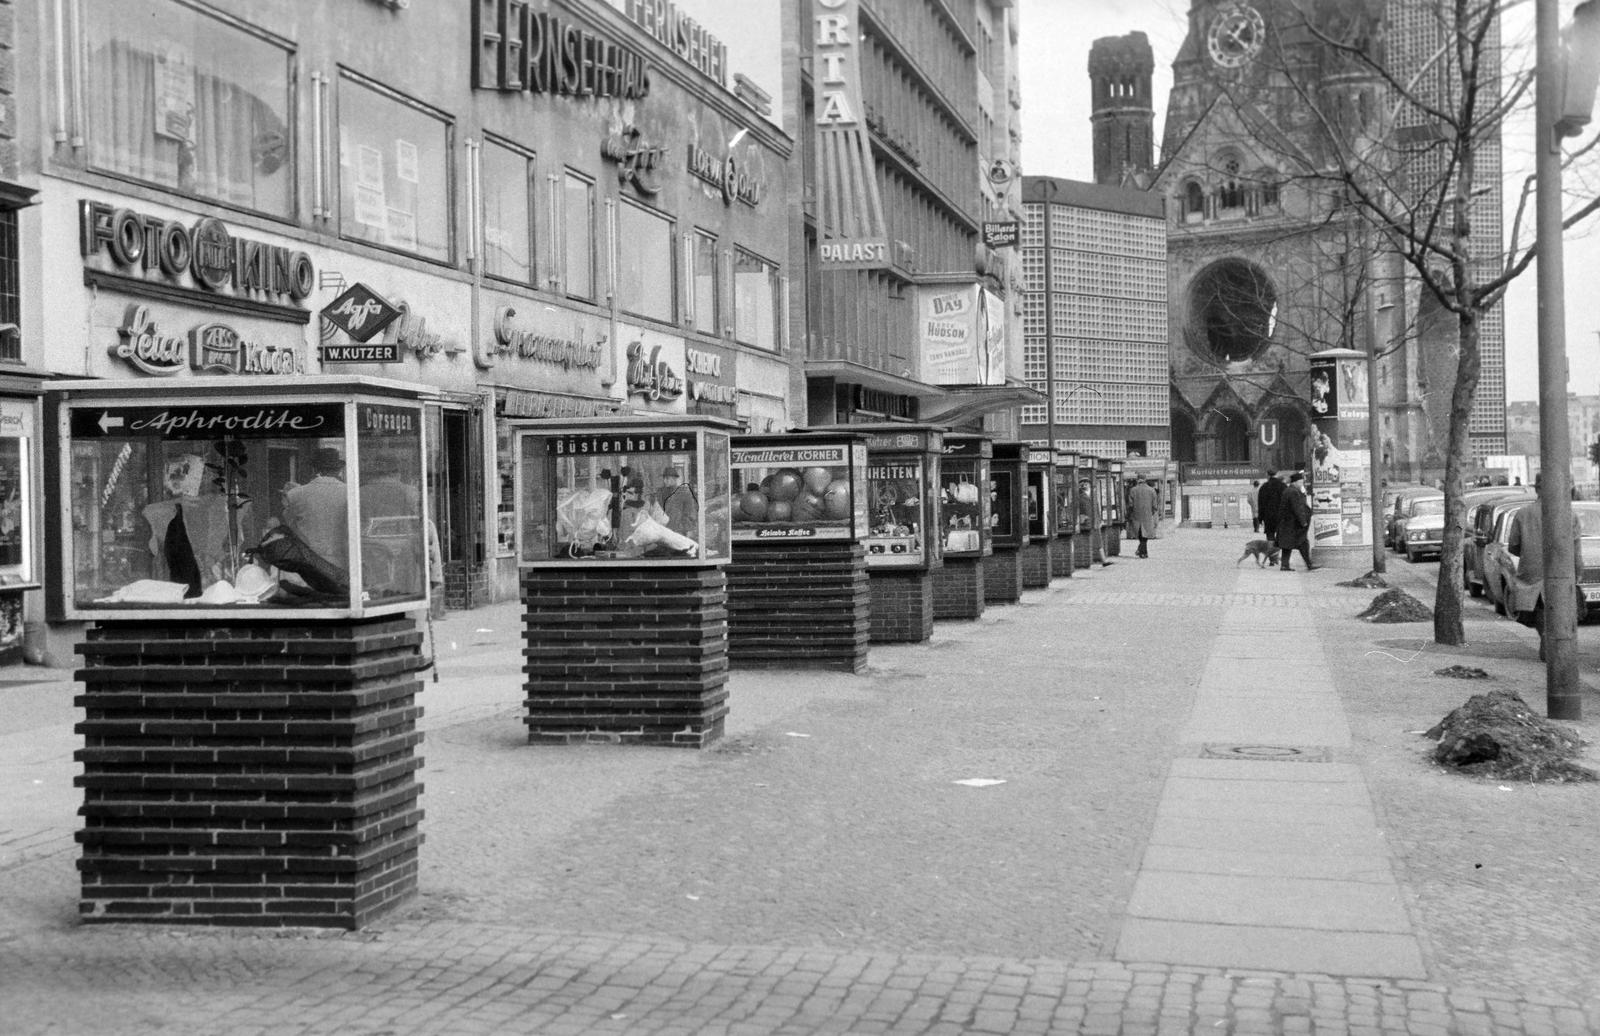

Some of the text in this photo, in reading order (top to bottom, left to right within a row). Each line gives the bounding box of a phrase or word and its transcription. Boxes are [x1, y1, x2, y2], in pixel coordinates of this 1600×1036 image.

[984, 223, 1017, 233] Billard-
[986, 232, 1015, 242] Salon
[79, 199, 314, 300] FOTO KINO
[820, 242, 884, 263] PALAST
[332, 296, 382, 330] Agfa
[933, 297, 963, 315] DAY
[115, 304, 185, 375] Leica
[927, 321, 965, 339] HUDSON
[328, 347, 393, 359] W.KUTZER
[131, 409, 324, 434] Aphrodite
[366, 407, 412, 431] Corsagen
[556, 435, 688, 454] Büstenhalter
[1261, 424, 1276, 445] U
[732, 449, 839, 462] Konditorei KÖRNER
